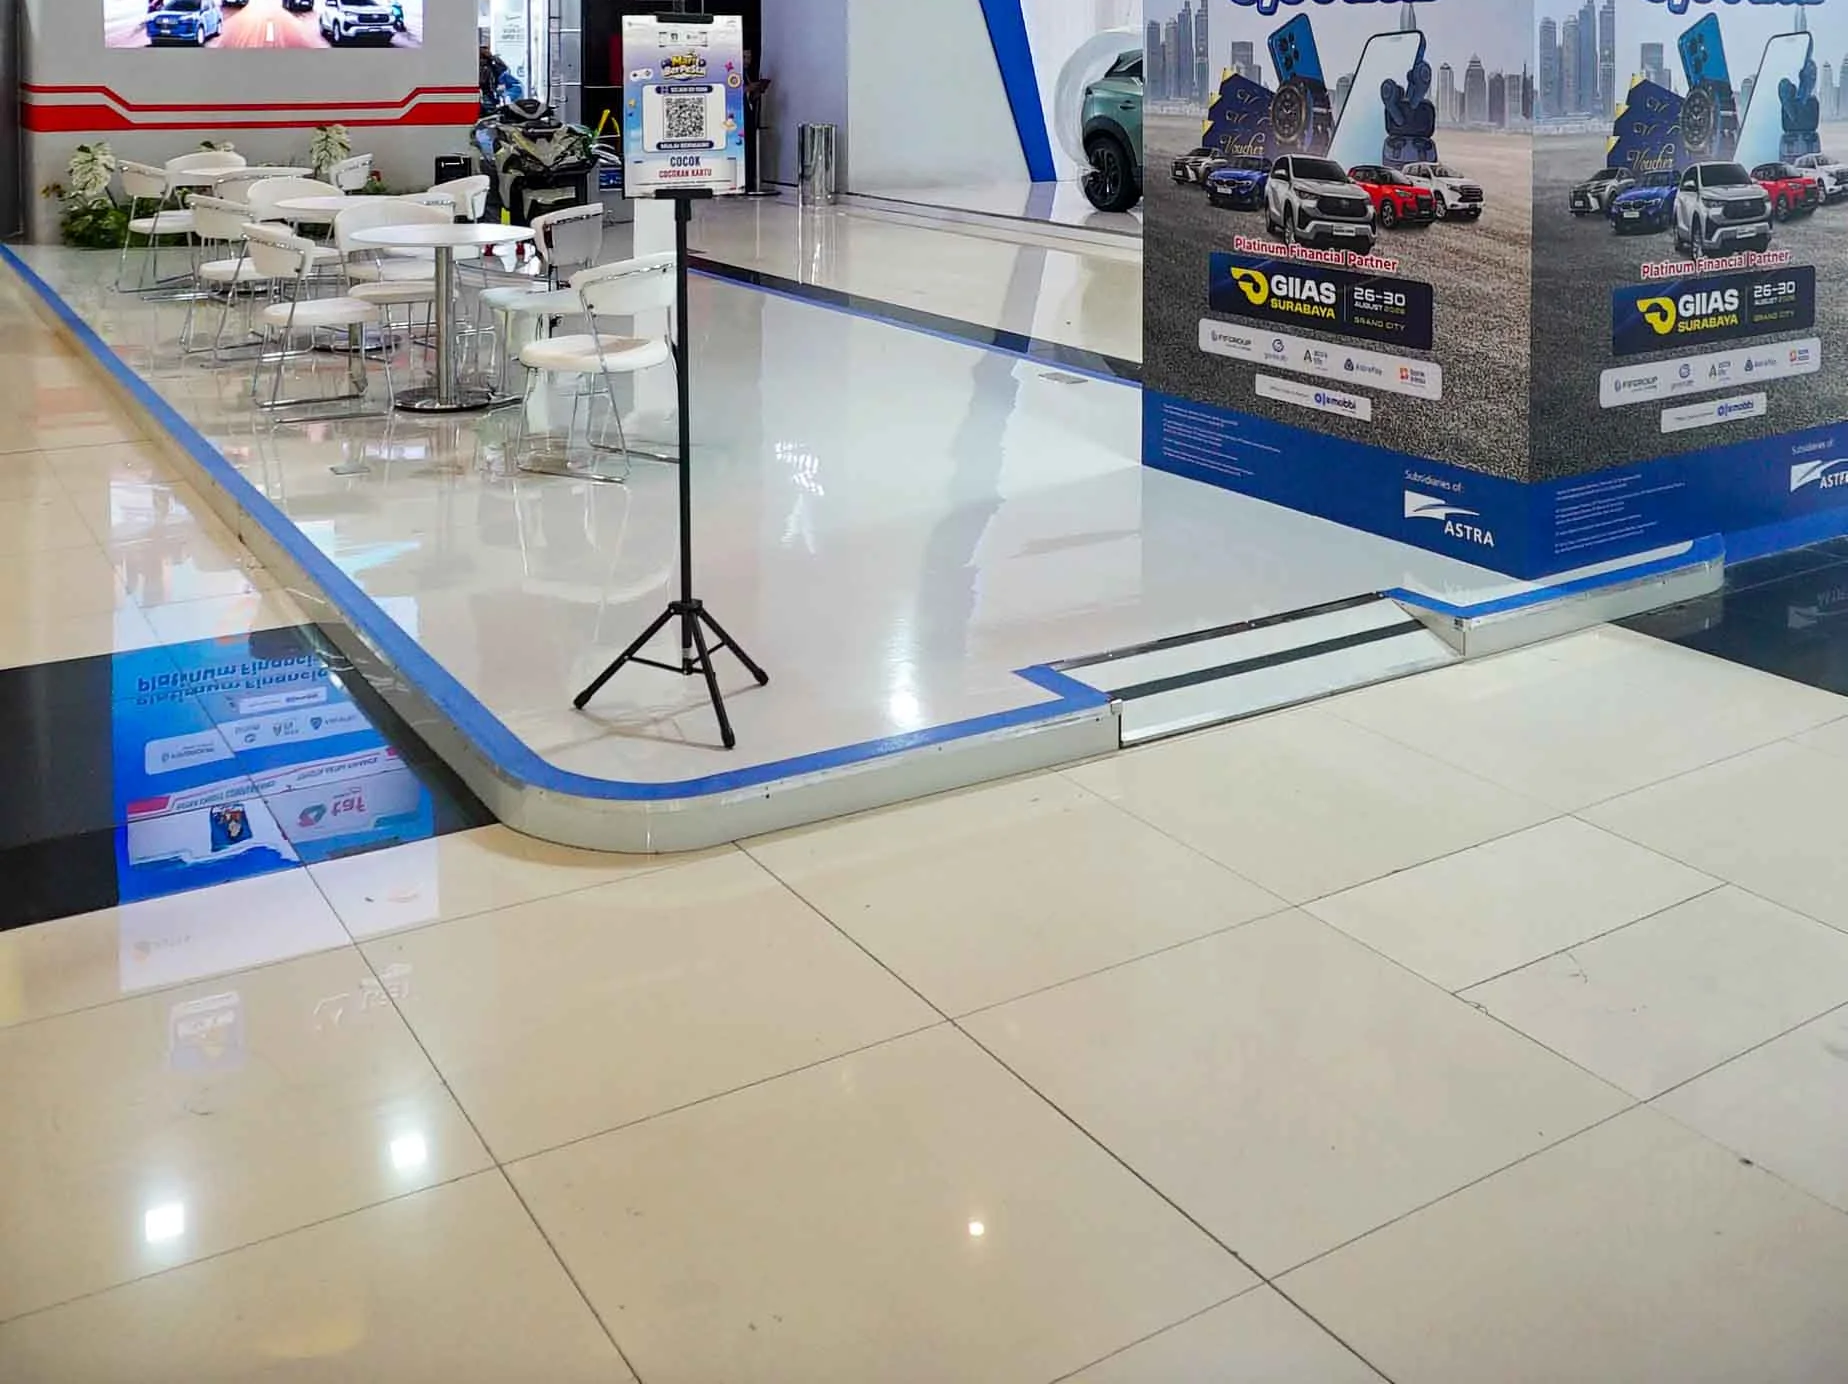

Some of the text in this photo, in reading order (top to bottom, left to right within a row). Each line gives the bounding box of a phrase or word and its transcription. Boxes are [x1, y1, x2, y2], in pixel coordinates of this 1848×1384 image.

[1220, 132, 1265, 155] Voucher
[670, 156, 701, 167] COCOK
[1626, 143, 1675, 171] Voucher
[691, 168, 712, 177] KARTU
[1234, 237, 1398, 271] Platinum Financial Partner
[1641, 251, 1790, 279] Platinum Financial Partner
[1271, 275, 1337, 304] GIIAS
[1354, 287, 1406, 306] 26-30
[1753, 281, 1796, 298] 26-30
[1270, 299, 1335, 320] SURABAYA
[1354, 301, 1383, 311] AUGUST
[1678, 289, 1739, 317] GIIAS
[1677, 315, 1738, 333] SURABAYA
[1820, 471, 1848, 489] ASTR
[1444, 520, 1494, 548] ASTRA
